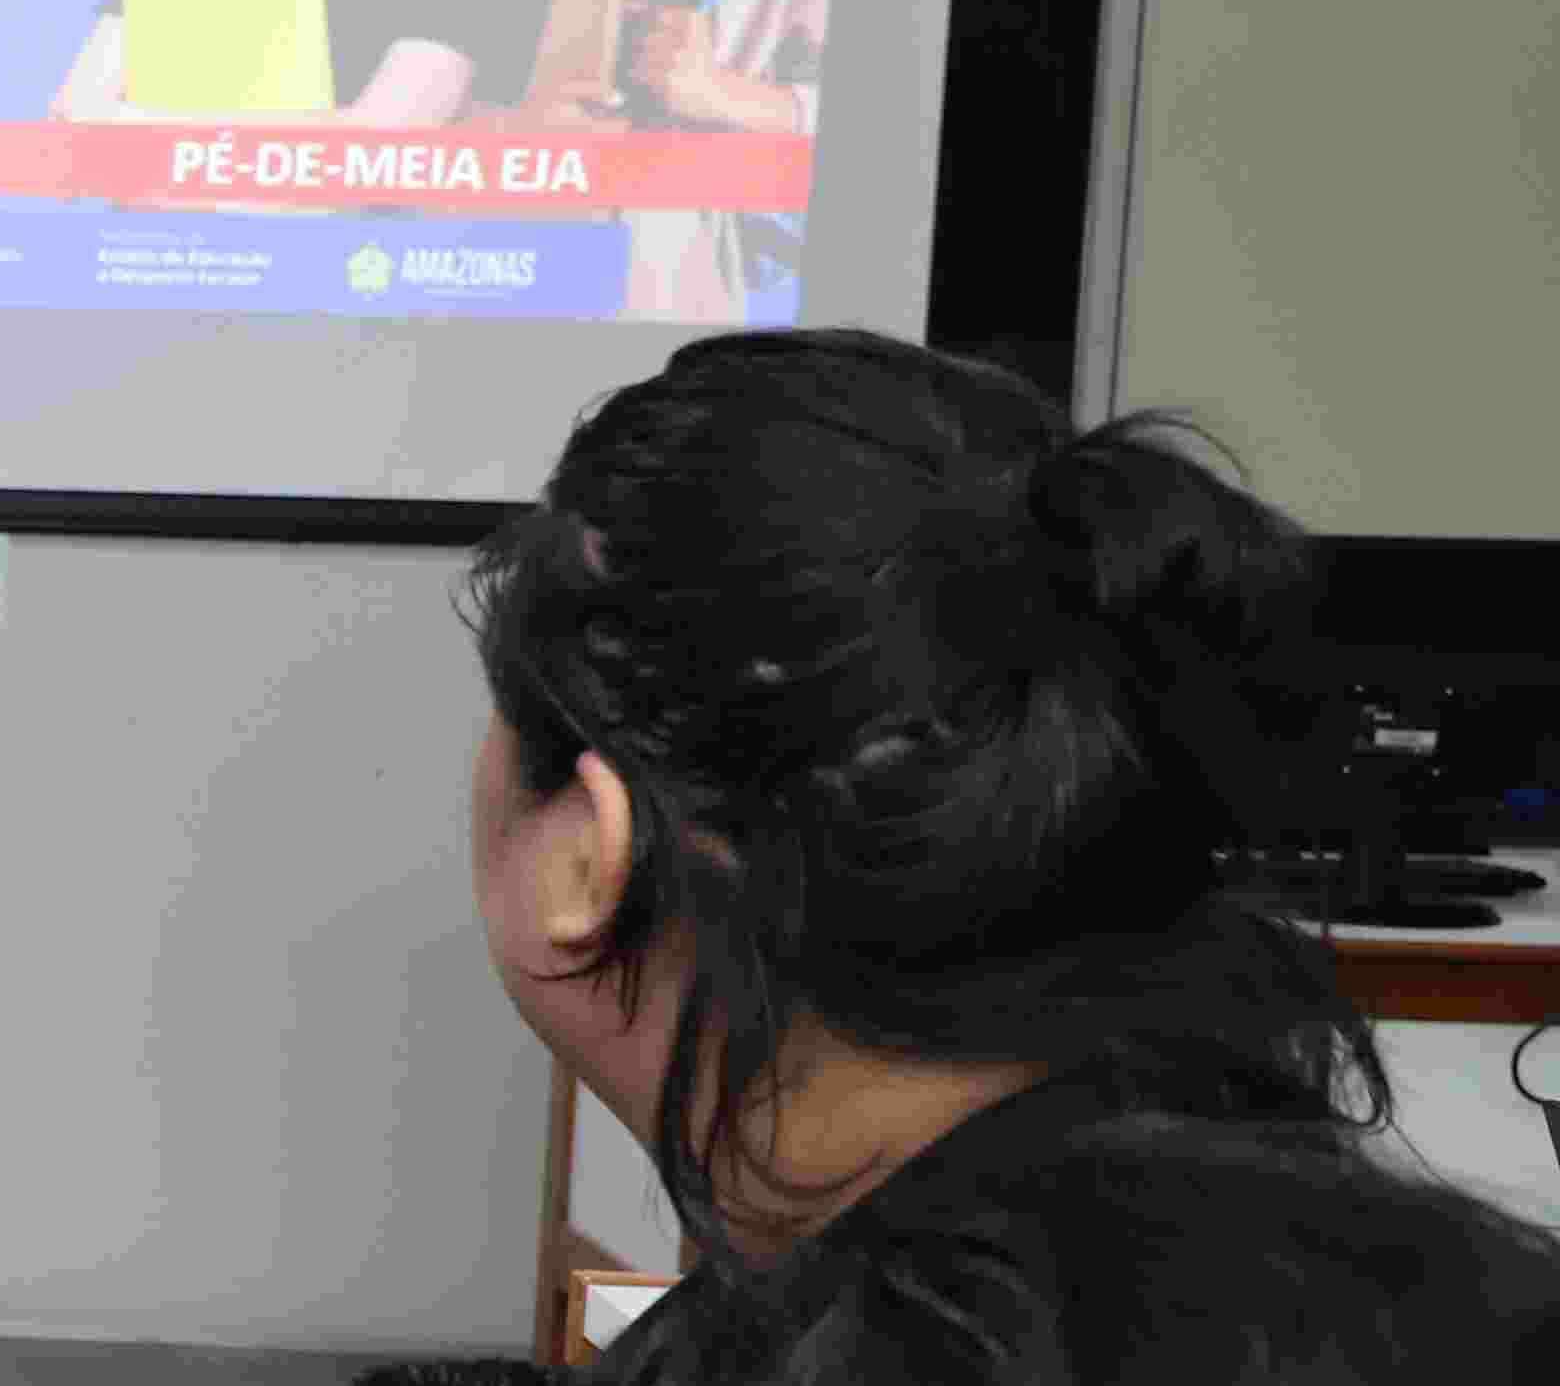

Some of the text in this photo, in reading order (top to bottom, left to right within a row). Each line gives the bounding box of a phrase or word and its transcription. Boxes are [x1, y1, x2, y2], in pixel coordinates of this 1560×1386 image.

[173, 129, 591, 196] PÉ-DE-MEIA EJA
[399, 245, 537, 287] AMAZONAS
